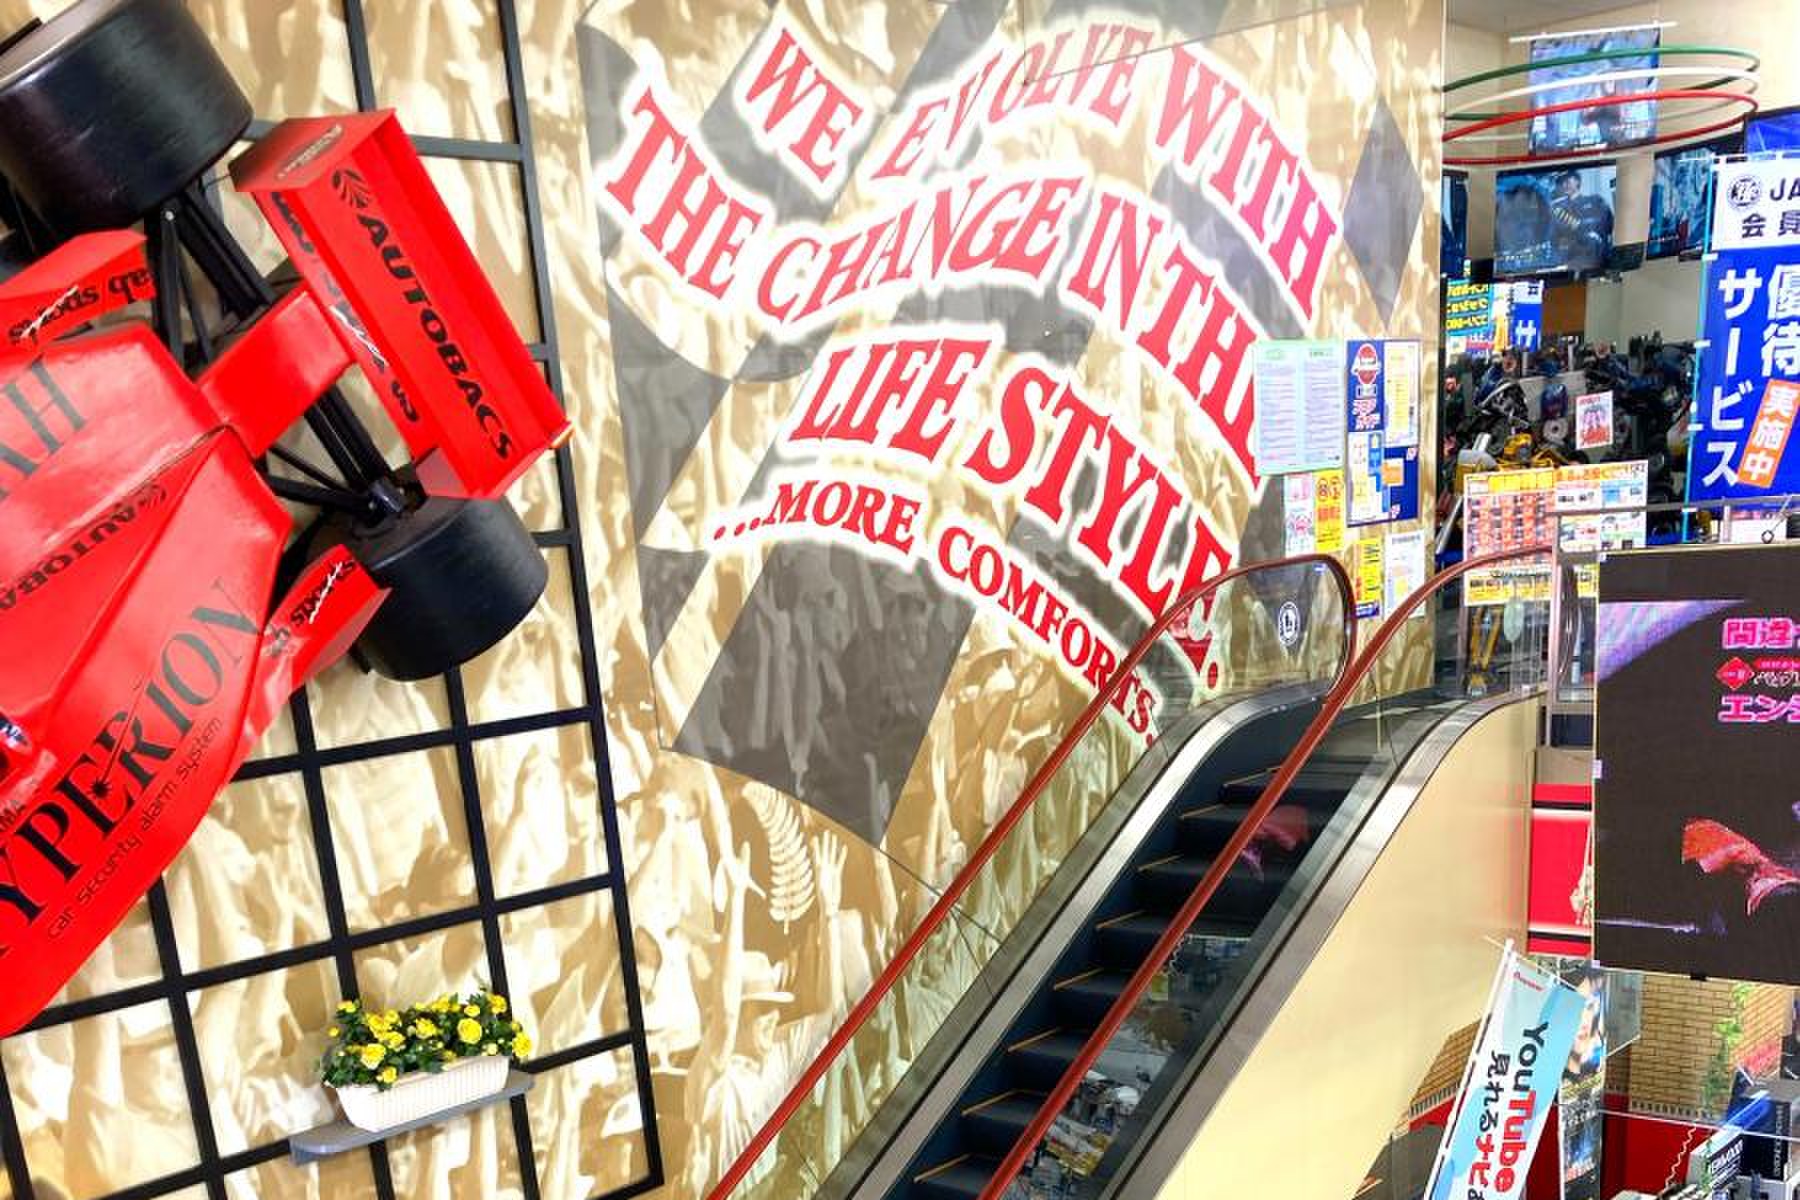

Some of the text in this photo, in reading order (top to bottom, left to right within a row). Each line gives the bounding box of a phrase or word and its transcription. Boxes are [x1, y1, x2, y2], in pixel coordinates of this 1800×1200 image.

[605, 87, 763, 300] THE
[757, 176, 1085, 324] CHANGE
[1068, 192, 1157, 331] IN
[745, 23, 1338, 320] WE EVOLVE WITH
[357, 213, 515, 460] AUTOBACS
[1702, 267, 1763, 487] サービス
[1743, 385, 1798, 482] 実施中
[789, 338, 994, 462] LIFE
[965, 366, 1235, 690] STYLE.
[1721, 617, 1800, 650] 間違
[0, 577, 260, 957] YPERION
[76, 835, 142, 907] security
[141, 777, 180, 833] alarm
[175, 716, 223, 780] system
[1493, 1021, 1550, 1193] YouTube
